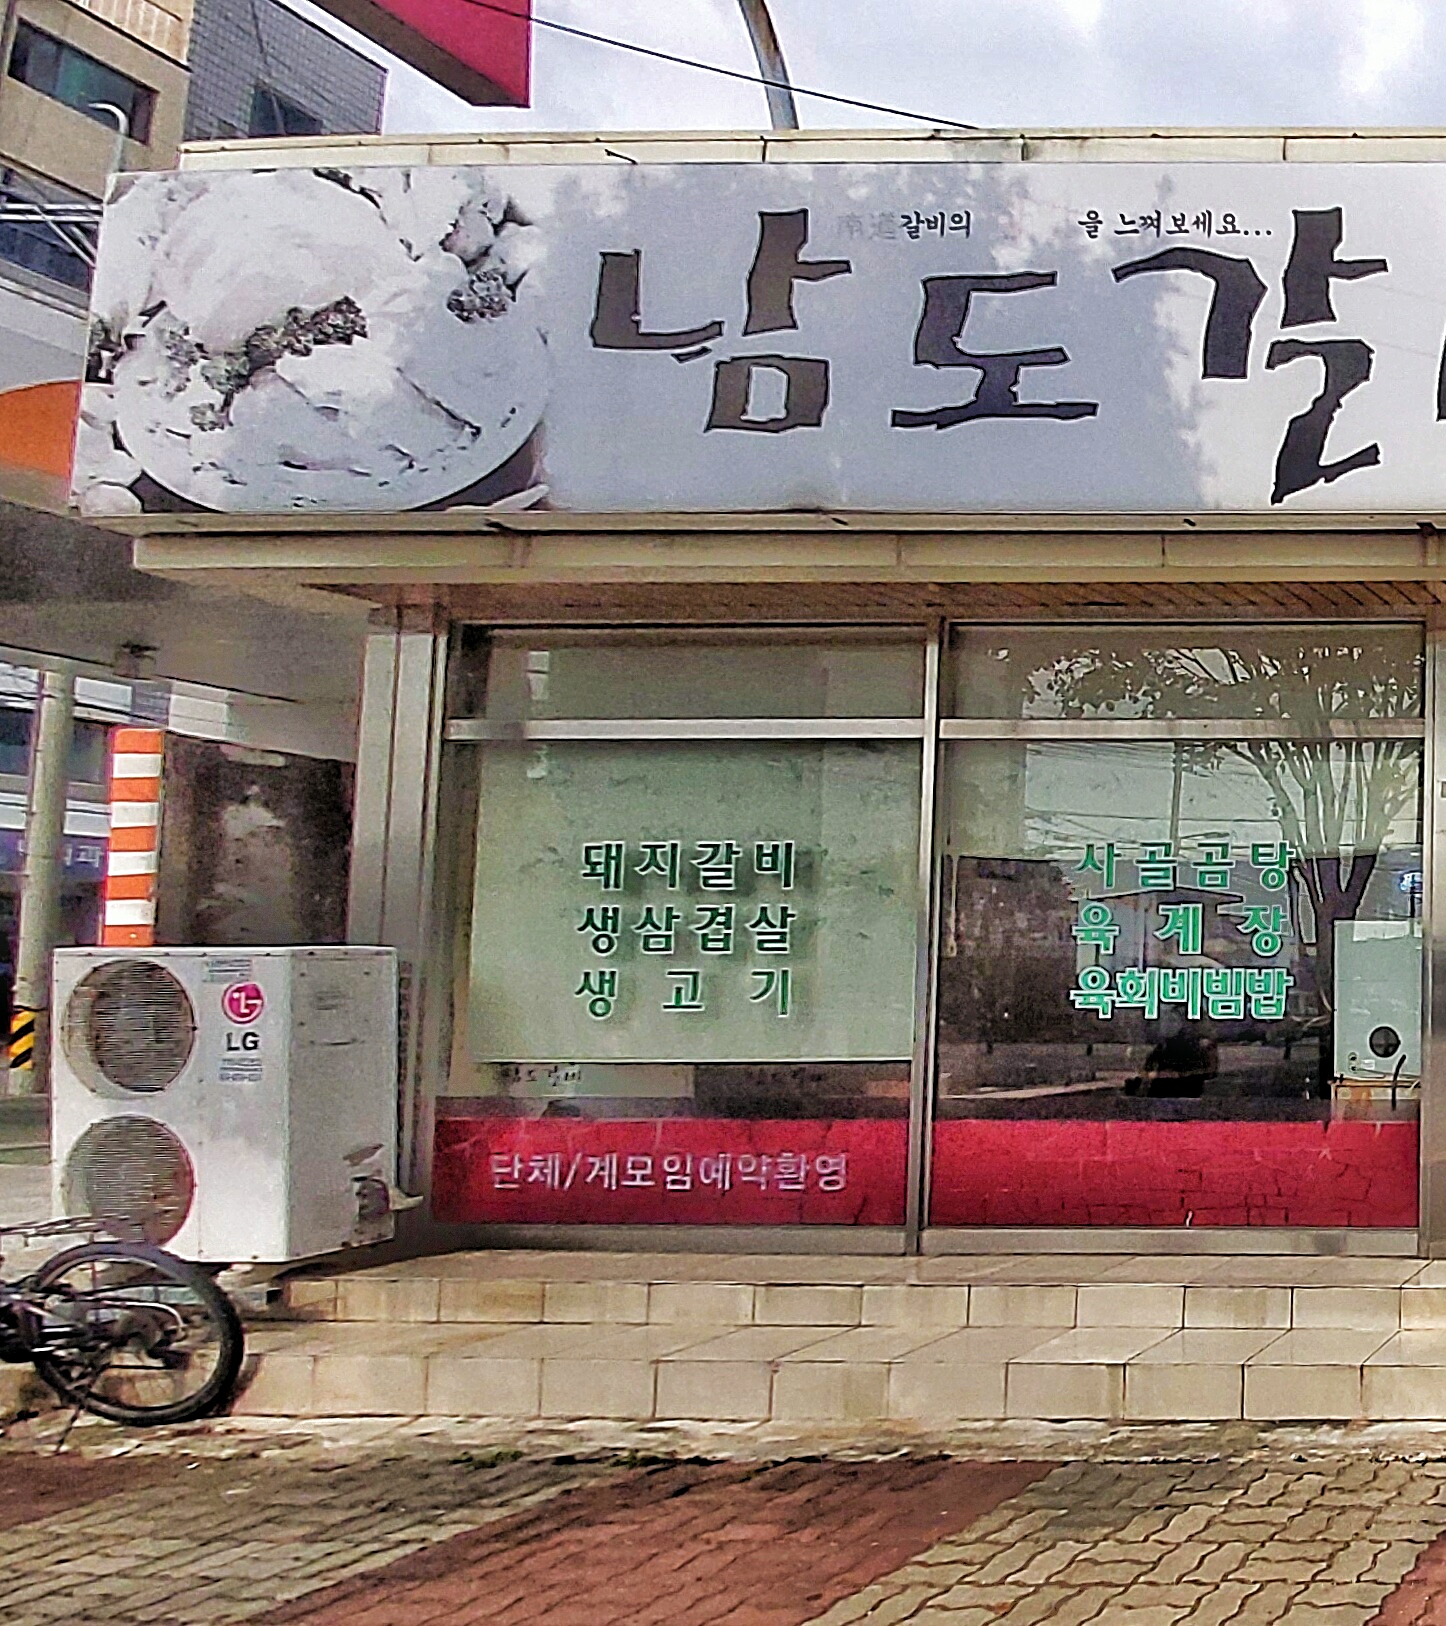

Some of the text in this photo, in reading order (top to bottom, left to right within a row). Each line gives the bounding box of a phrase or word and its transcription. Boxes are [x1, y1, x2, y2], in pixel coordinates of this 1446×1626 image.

[580, 840, 796, 891] 돼지갈비
[1074, 841, 1297, 891] 사골곰탕
[576, 904, 797, 955] 생삼겹살
[1072, 902, 1291, 957] 육계장
[574, 969, 793, 1018] 생고기
[1070, 967, 1295, 1021] 육회비빔밥
[226, 1032, 260, 1051] LG
[491, 1152, 849, 1191] 단체/계모임예약환영
